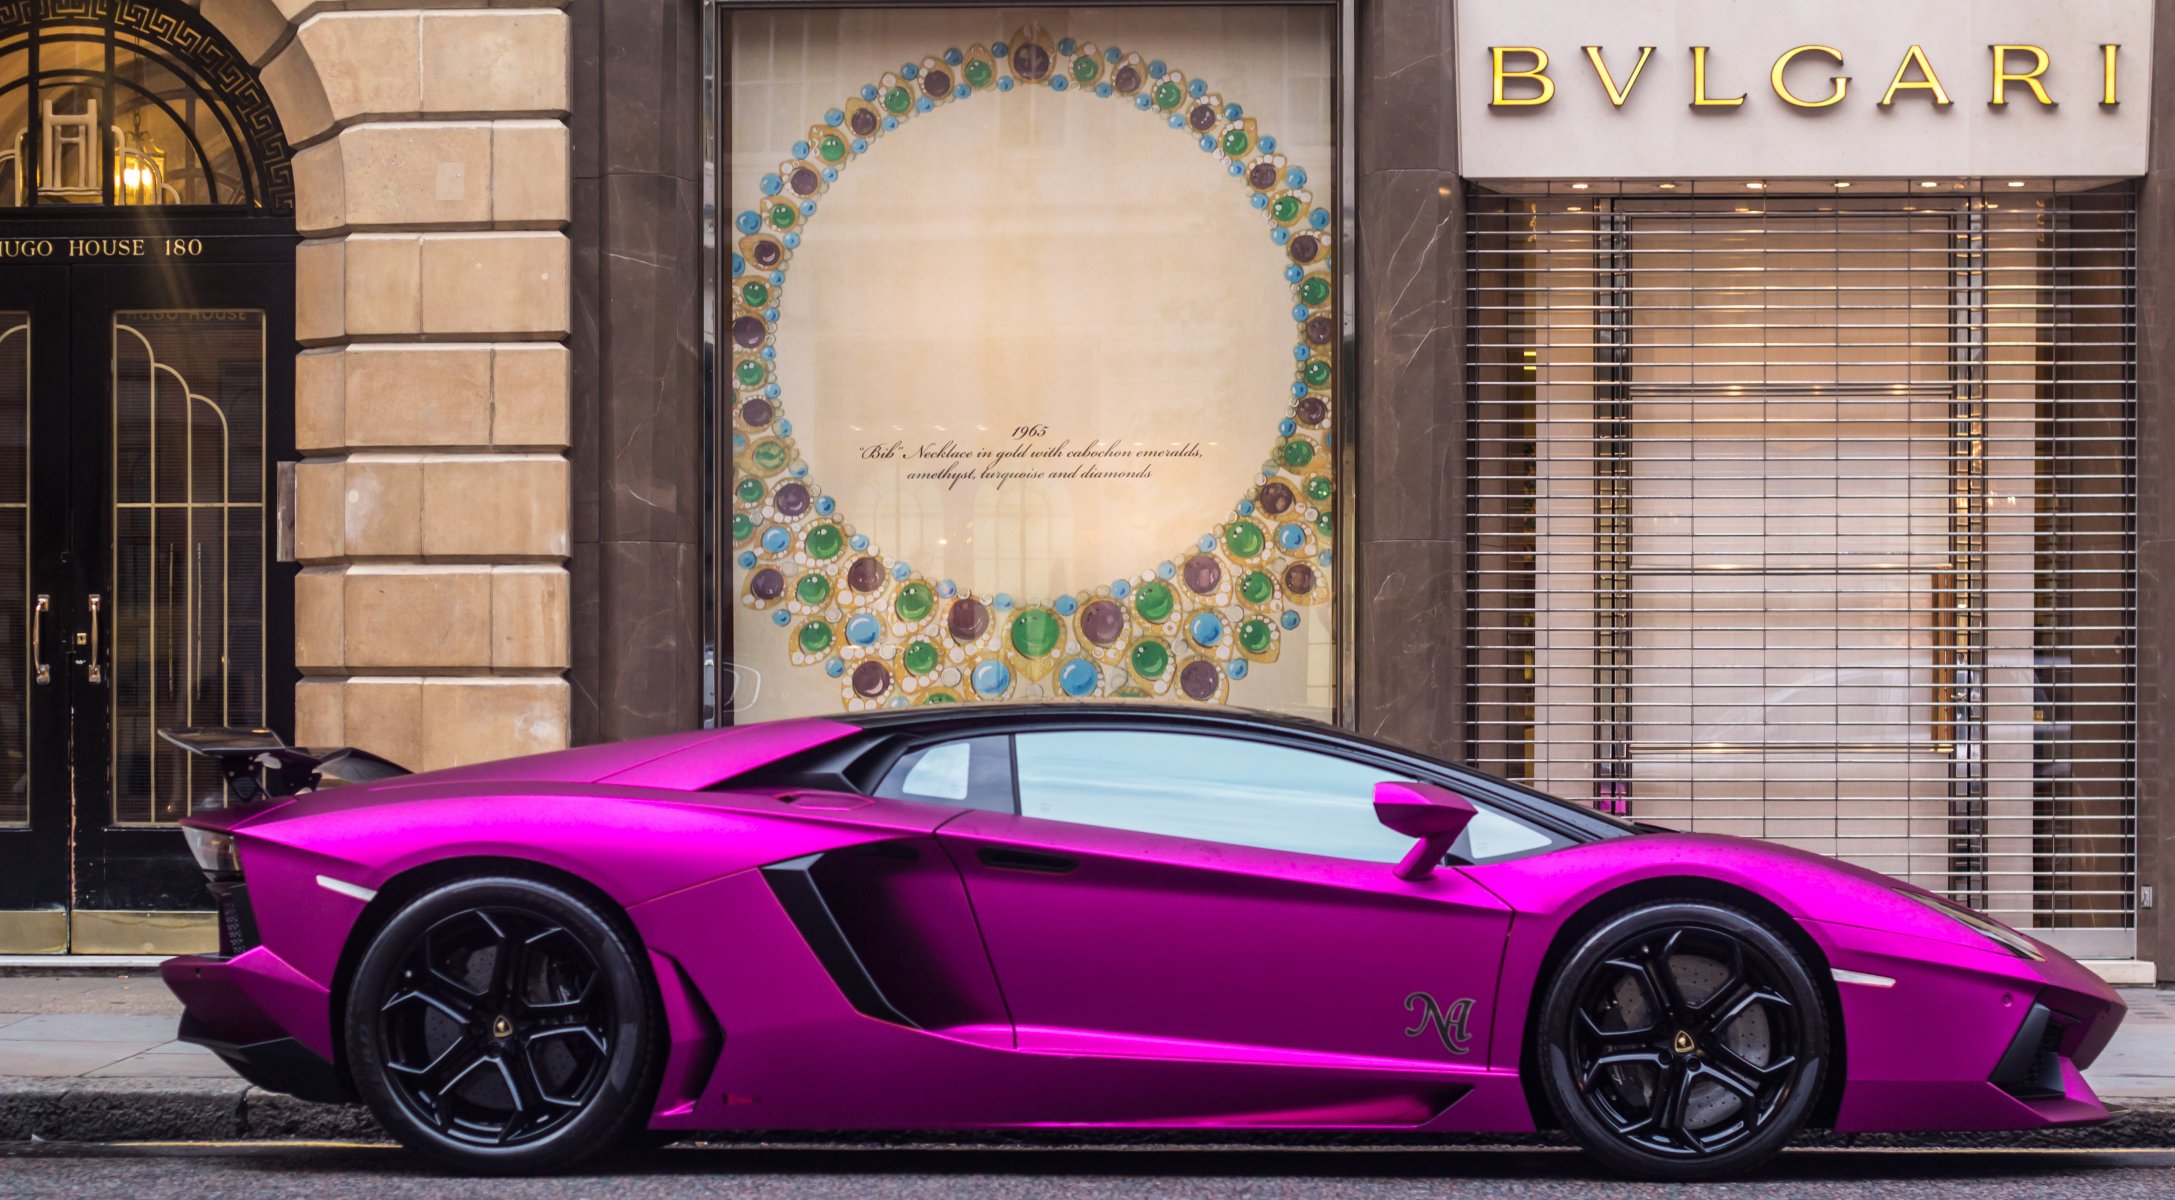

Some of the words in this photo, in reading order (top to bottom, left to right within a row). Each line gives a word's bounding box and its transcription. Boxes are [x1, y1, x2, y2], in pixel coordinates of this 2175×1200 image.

[1487, 44, 2122, 108] BVLGARI
[0, 240, 53, 257] UGO
[69, 239, 145, 256] HOUSE
[165, 238, 203, 256] 180
[1011, 424, 1049, 440] 1965
[903, 440, 973, 460] Necklace
[976, 447, 992, 458] in
[988, 443, 1033, 468] gold
[1030, 439, 1070, 458] with
[1066, 439, 1132, 458] cabochon
[1136, 442, 1203, 459] emeralds,
[906, 461, 976, 491] amethyst,
[980, 464, 1044, 490] turquoise
[1048, 463, 1083, 479] and
[1080, 463, 1152, 479] diamonds
